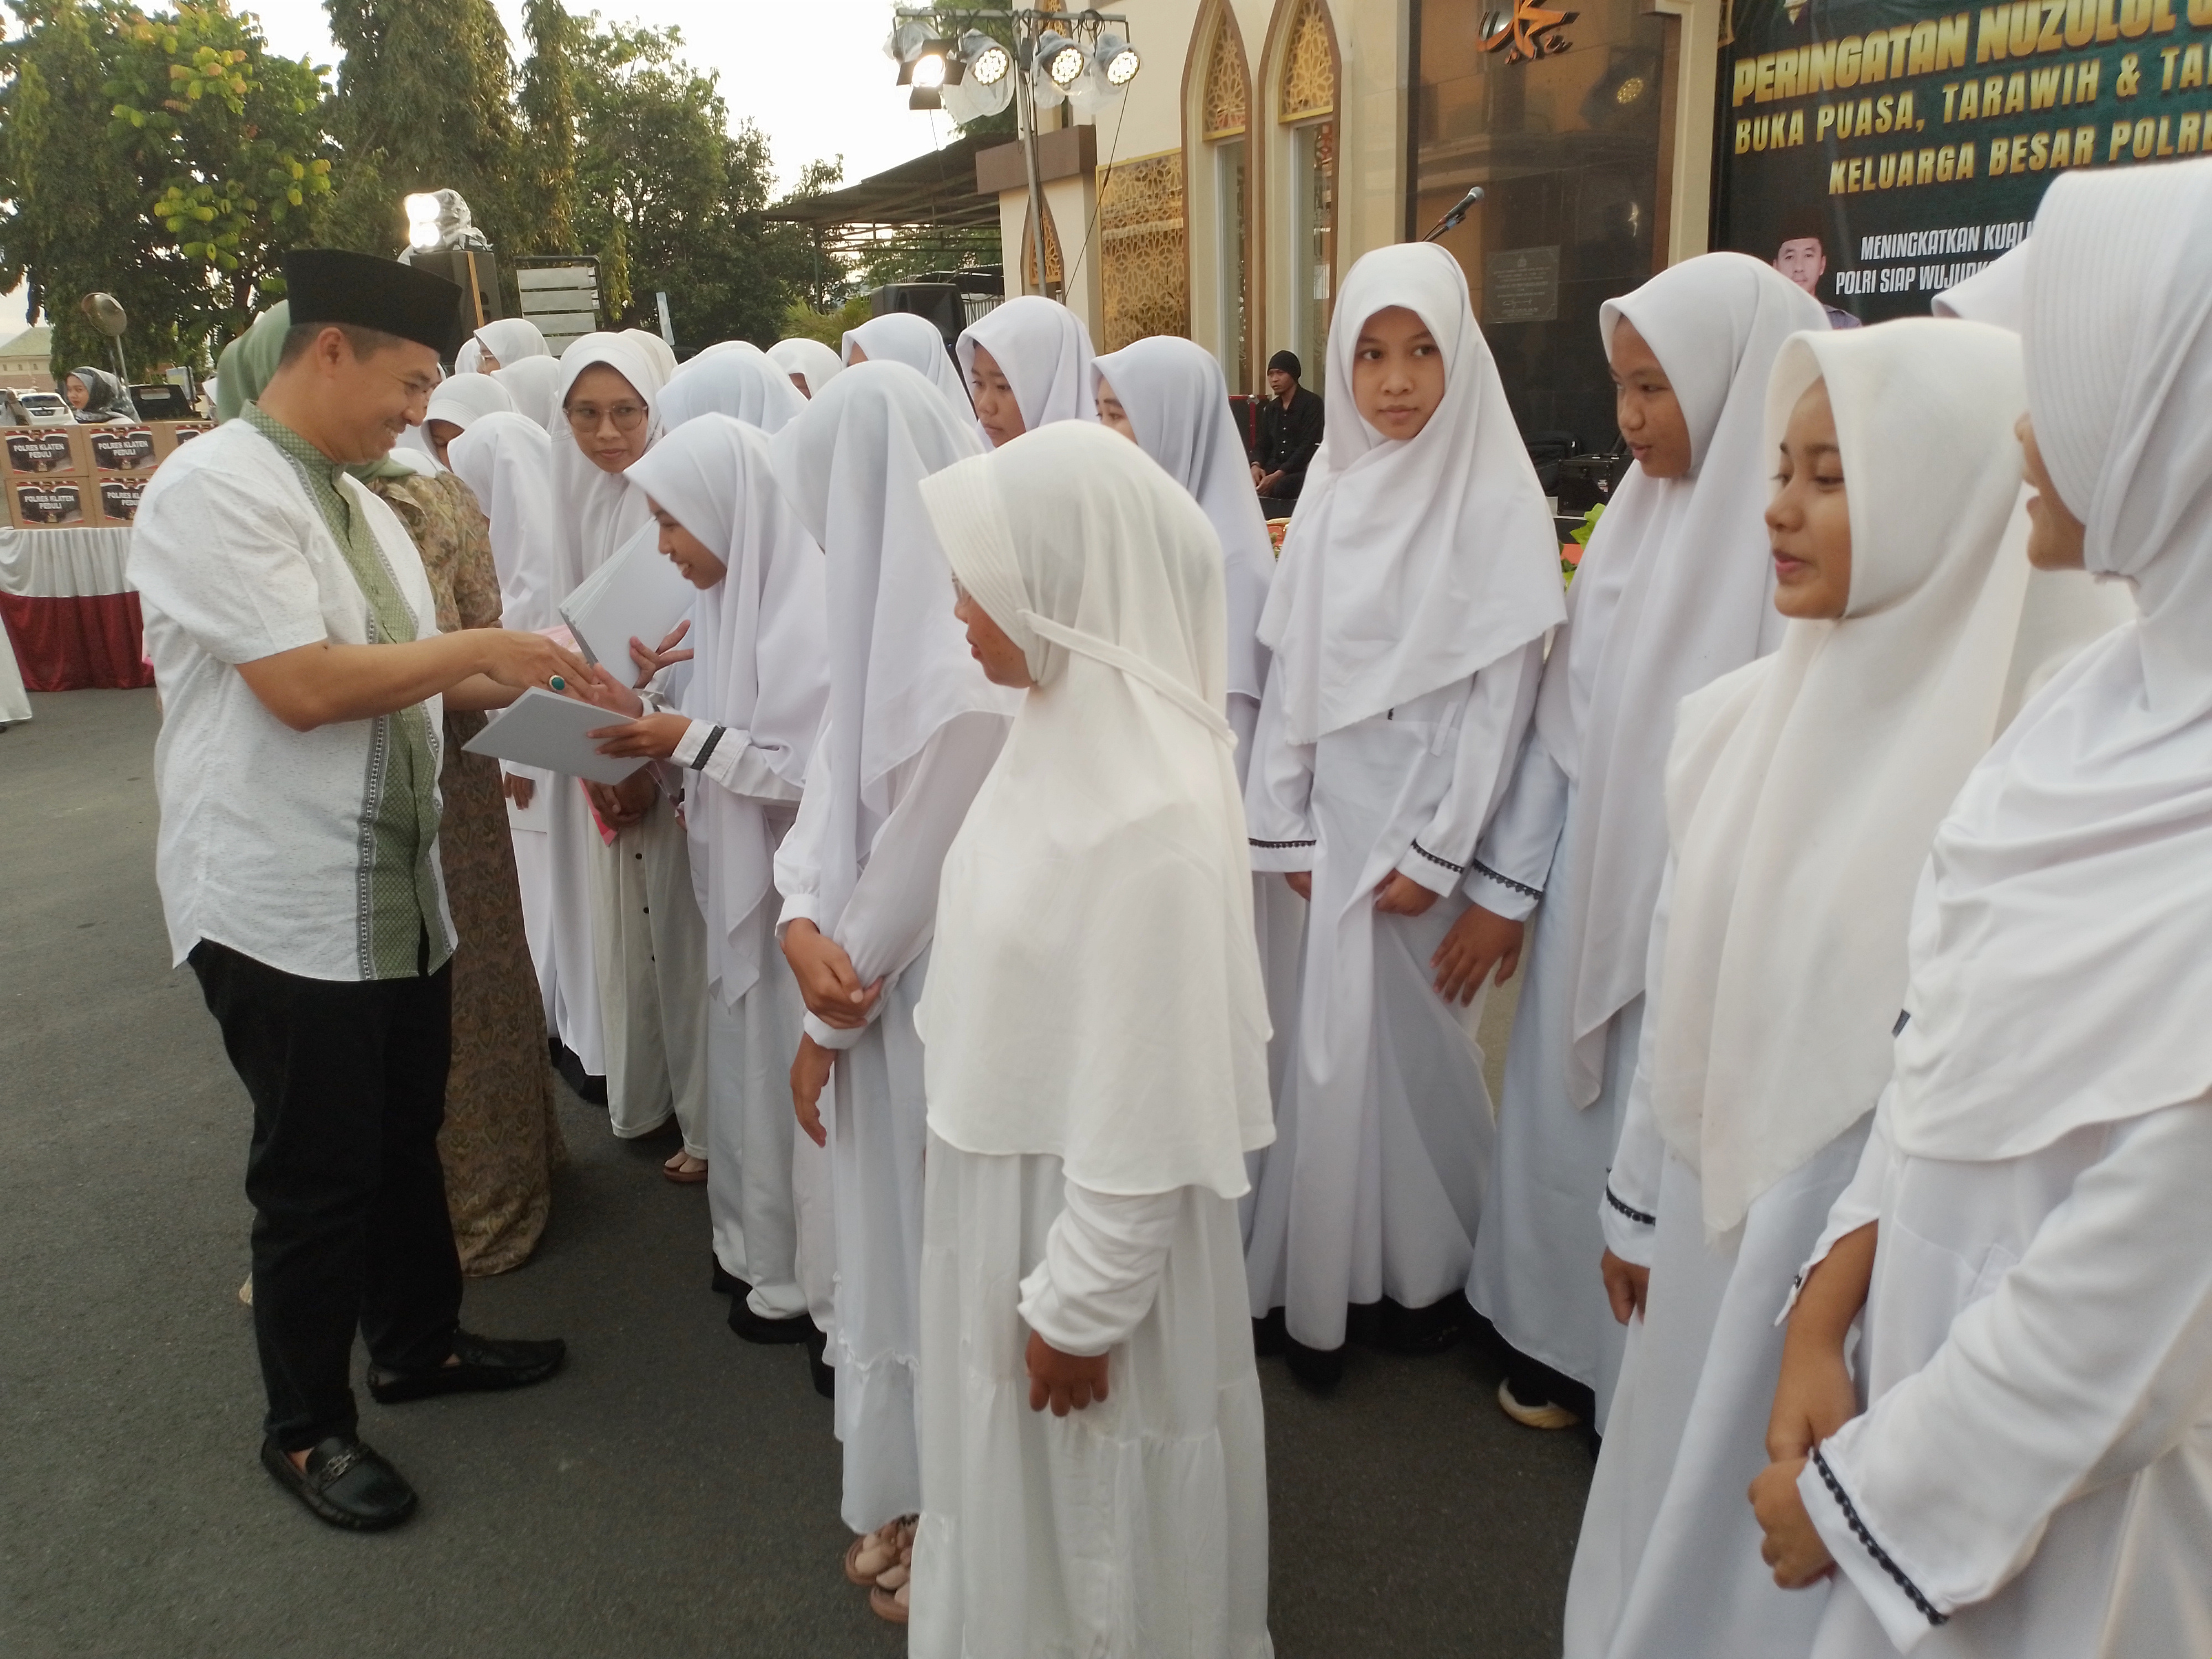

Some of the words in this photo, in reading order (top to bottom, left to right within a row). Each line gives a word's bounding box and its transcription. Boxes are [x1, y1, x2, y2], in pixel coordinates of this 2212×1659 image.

[1732, 12, 1969, 107] PERINGATAN
[1976, 0, 2176, 64] NUZULUL
[1735, 109, 1804, 155] BUKA
[1816, 90, 1925, 142] PUASA,
[1943, 58, 2100, 123] TARAWIH
[2116, 53, 2141, 97] &
[2160, 43, 2212, 91] TA
[1829, 142, 1975, 195] KELUARGA
[1989, 125, 2096, 176] BESAR
[1835, 269, 1877, 295] POLRI
[1880, 267, 1916, 293] SIAP
[1919, 260, 1995, 291] WUJUD
[1860, 226, 1981, 261] MENINGKATKAN
